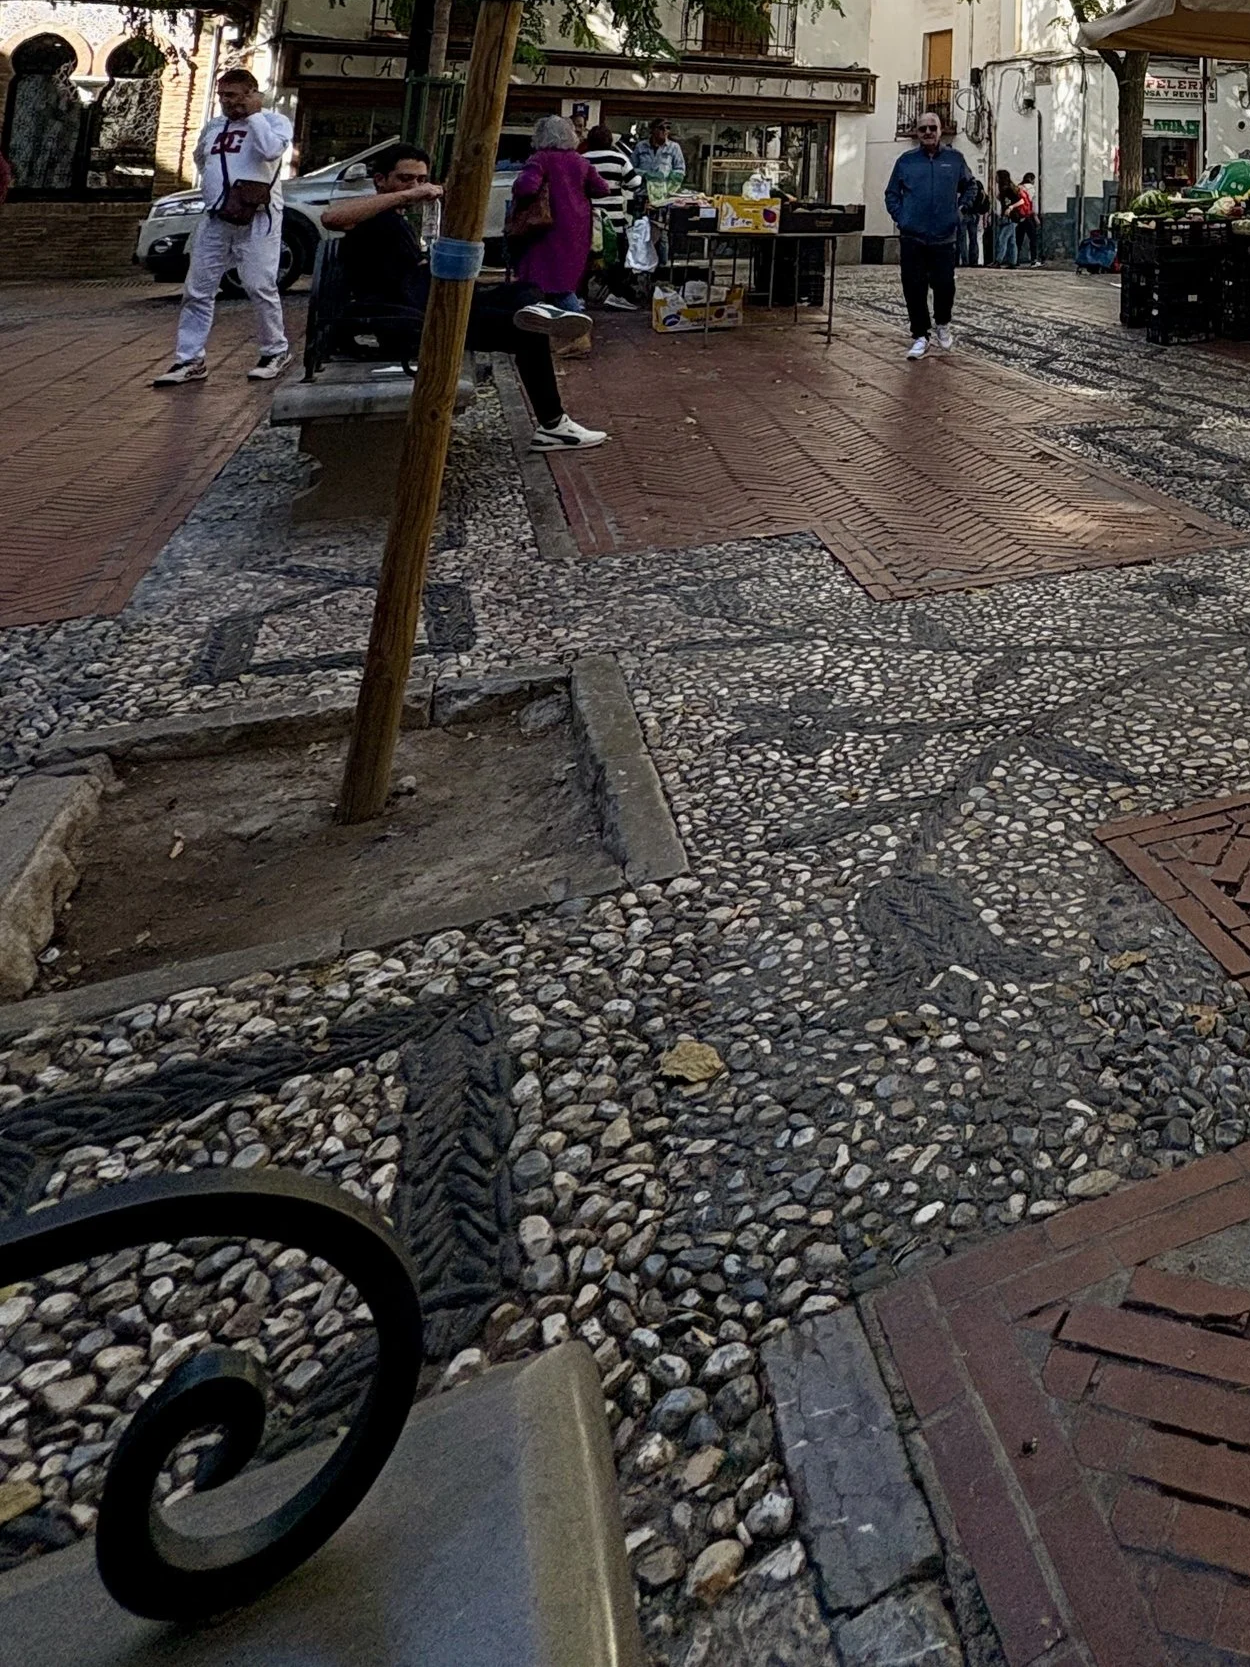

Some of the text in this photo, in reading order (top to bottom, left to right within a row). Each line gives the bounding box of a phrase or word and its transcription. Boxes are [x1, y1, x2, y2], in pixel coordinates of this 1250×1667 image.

[641, 71, 844, 100] PASTELES
[1145, 79, 1215, 91] PELERIA
[1172, 91, 1215, 99] REVISTS
